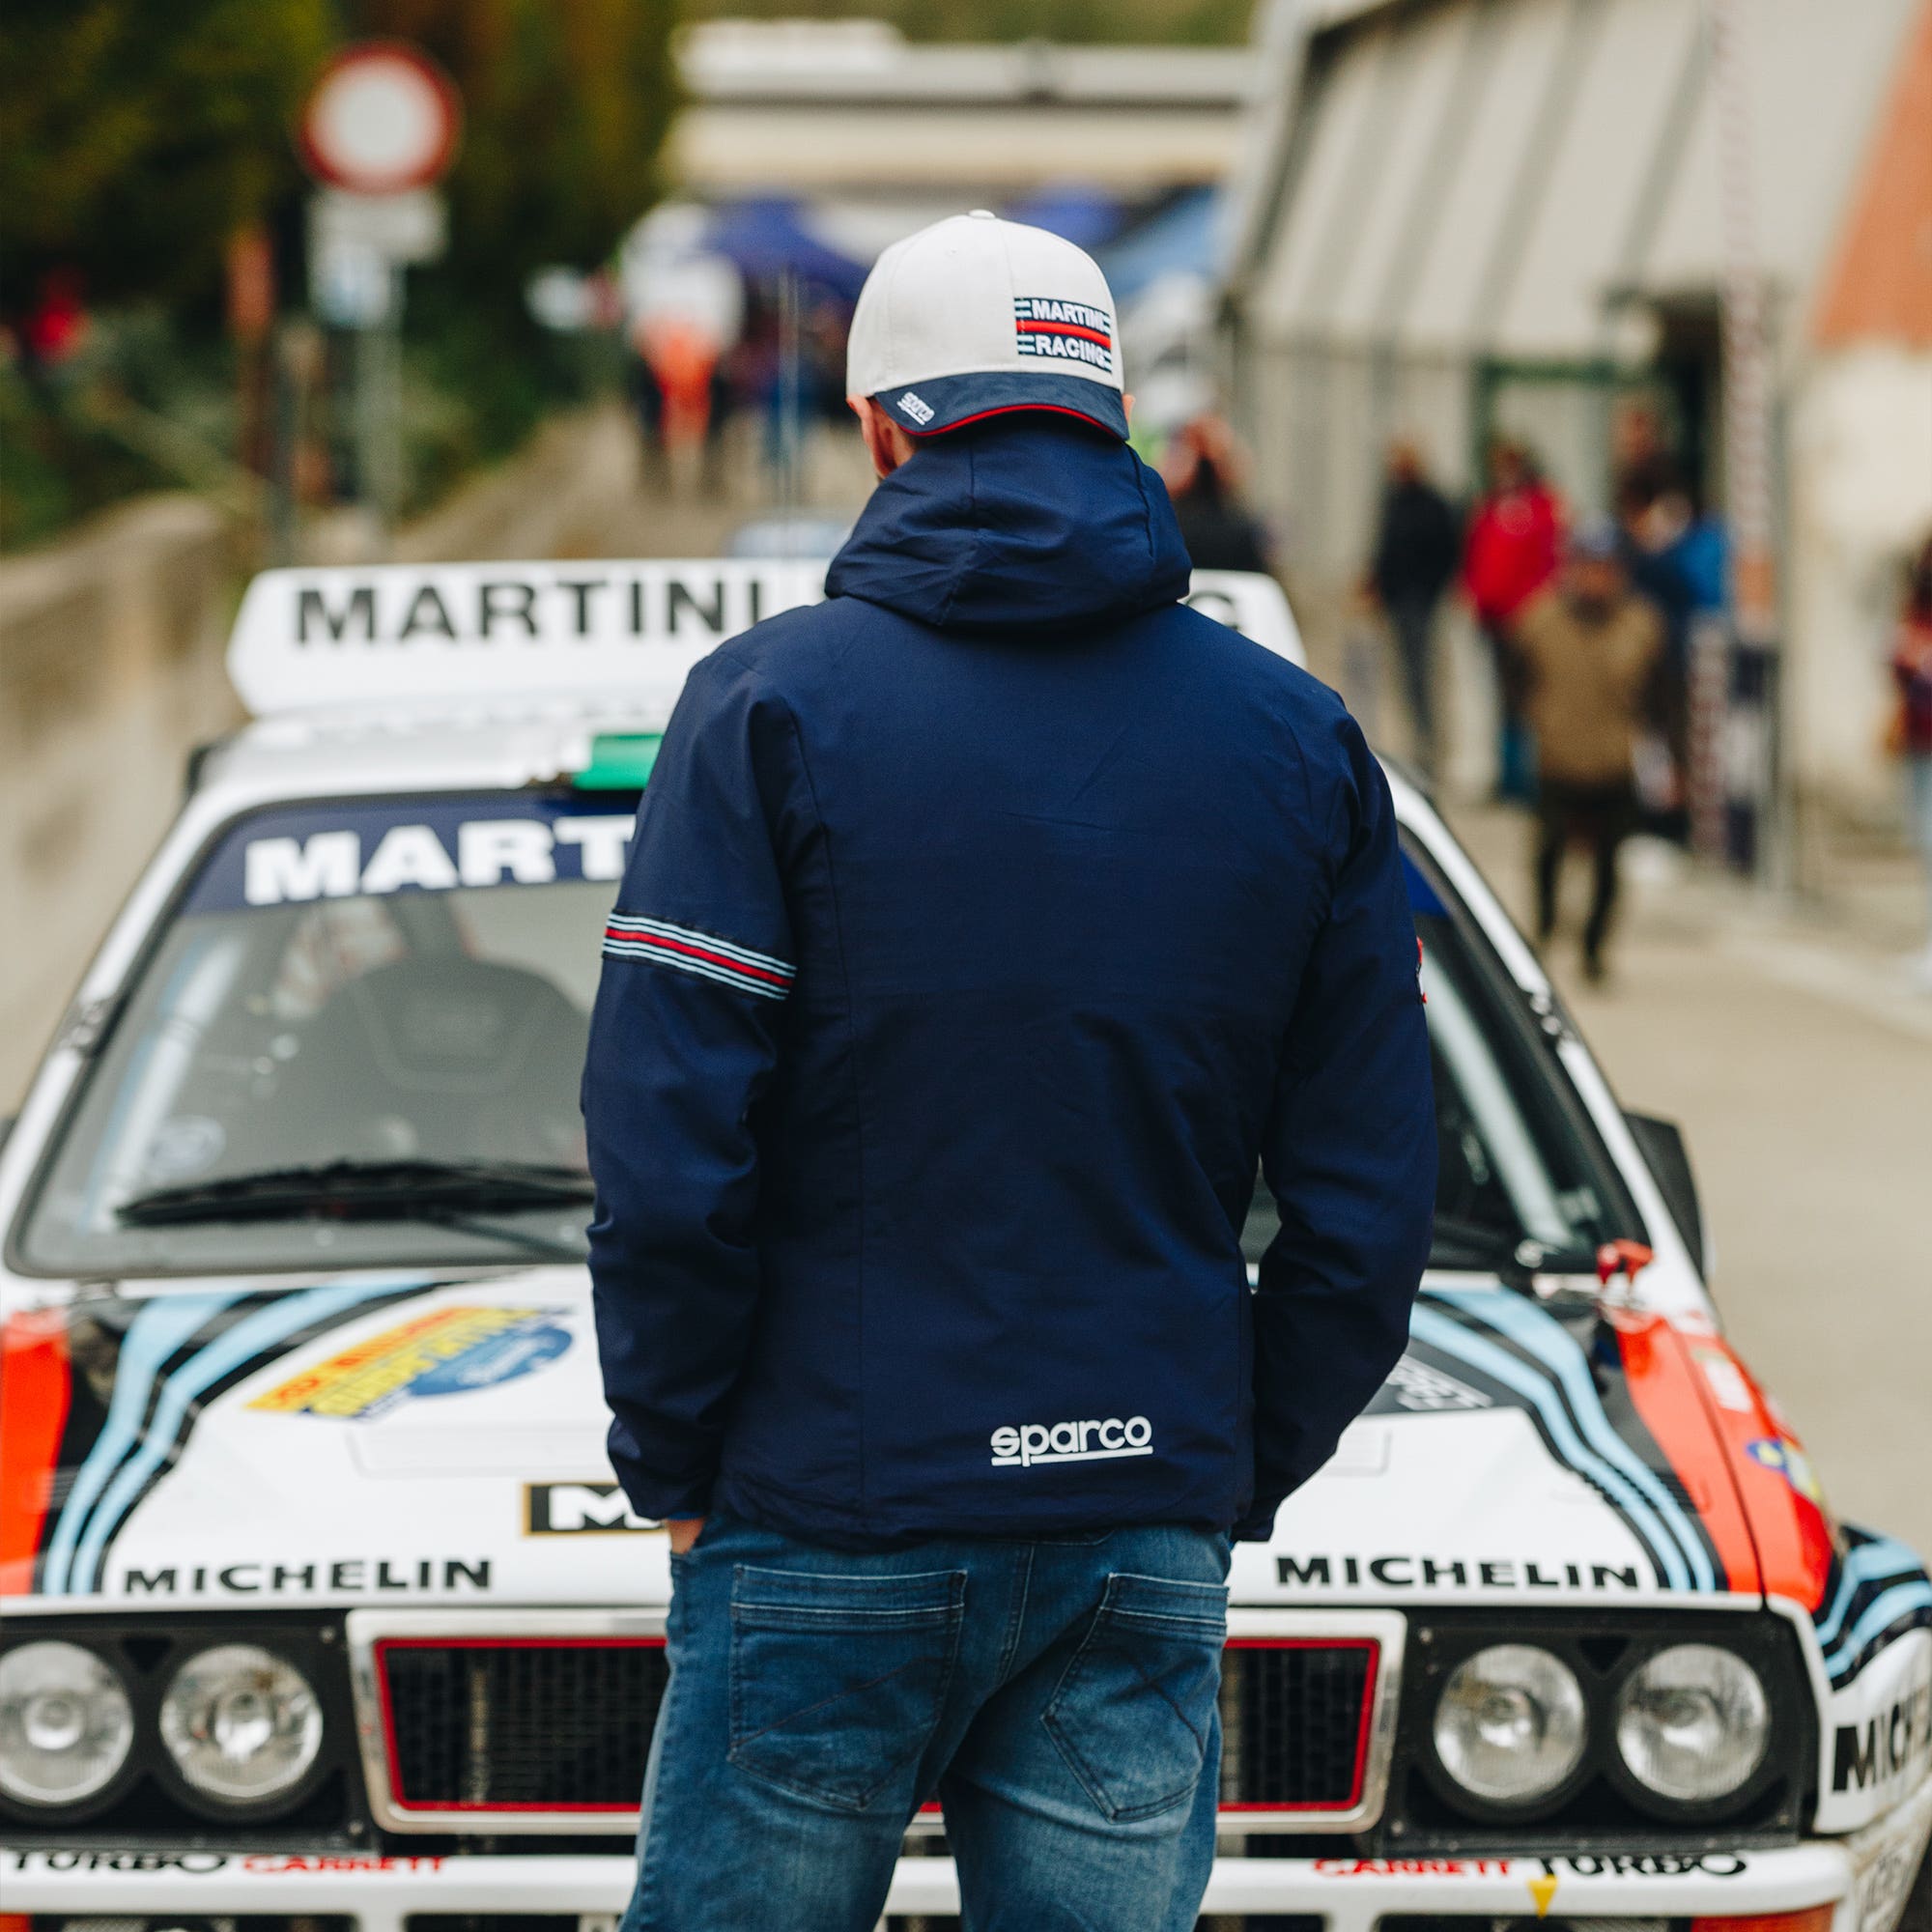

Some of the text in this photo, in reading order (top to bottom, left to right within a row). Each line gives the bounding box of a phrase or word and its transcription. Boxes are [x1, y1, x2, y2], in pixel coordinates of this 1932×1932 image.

[1035, 334, 1108, 368] RACING
[990, 1415, 1153, 1467] sparco
[124, 1559, 492, 1594] MICHELIN
[1276, 1556, 1638, 1589] MICHELIN
[8, 1848, 228, 1873] TURBO
[1536, 1851, 1747, 1876] TURBO
